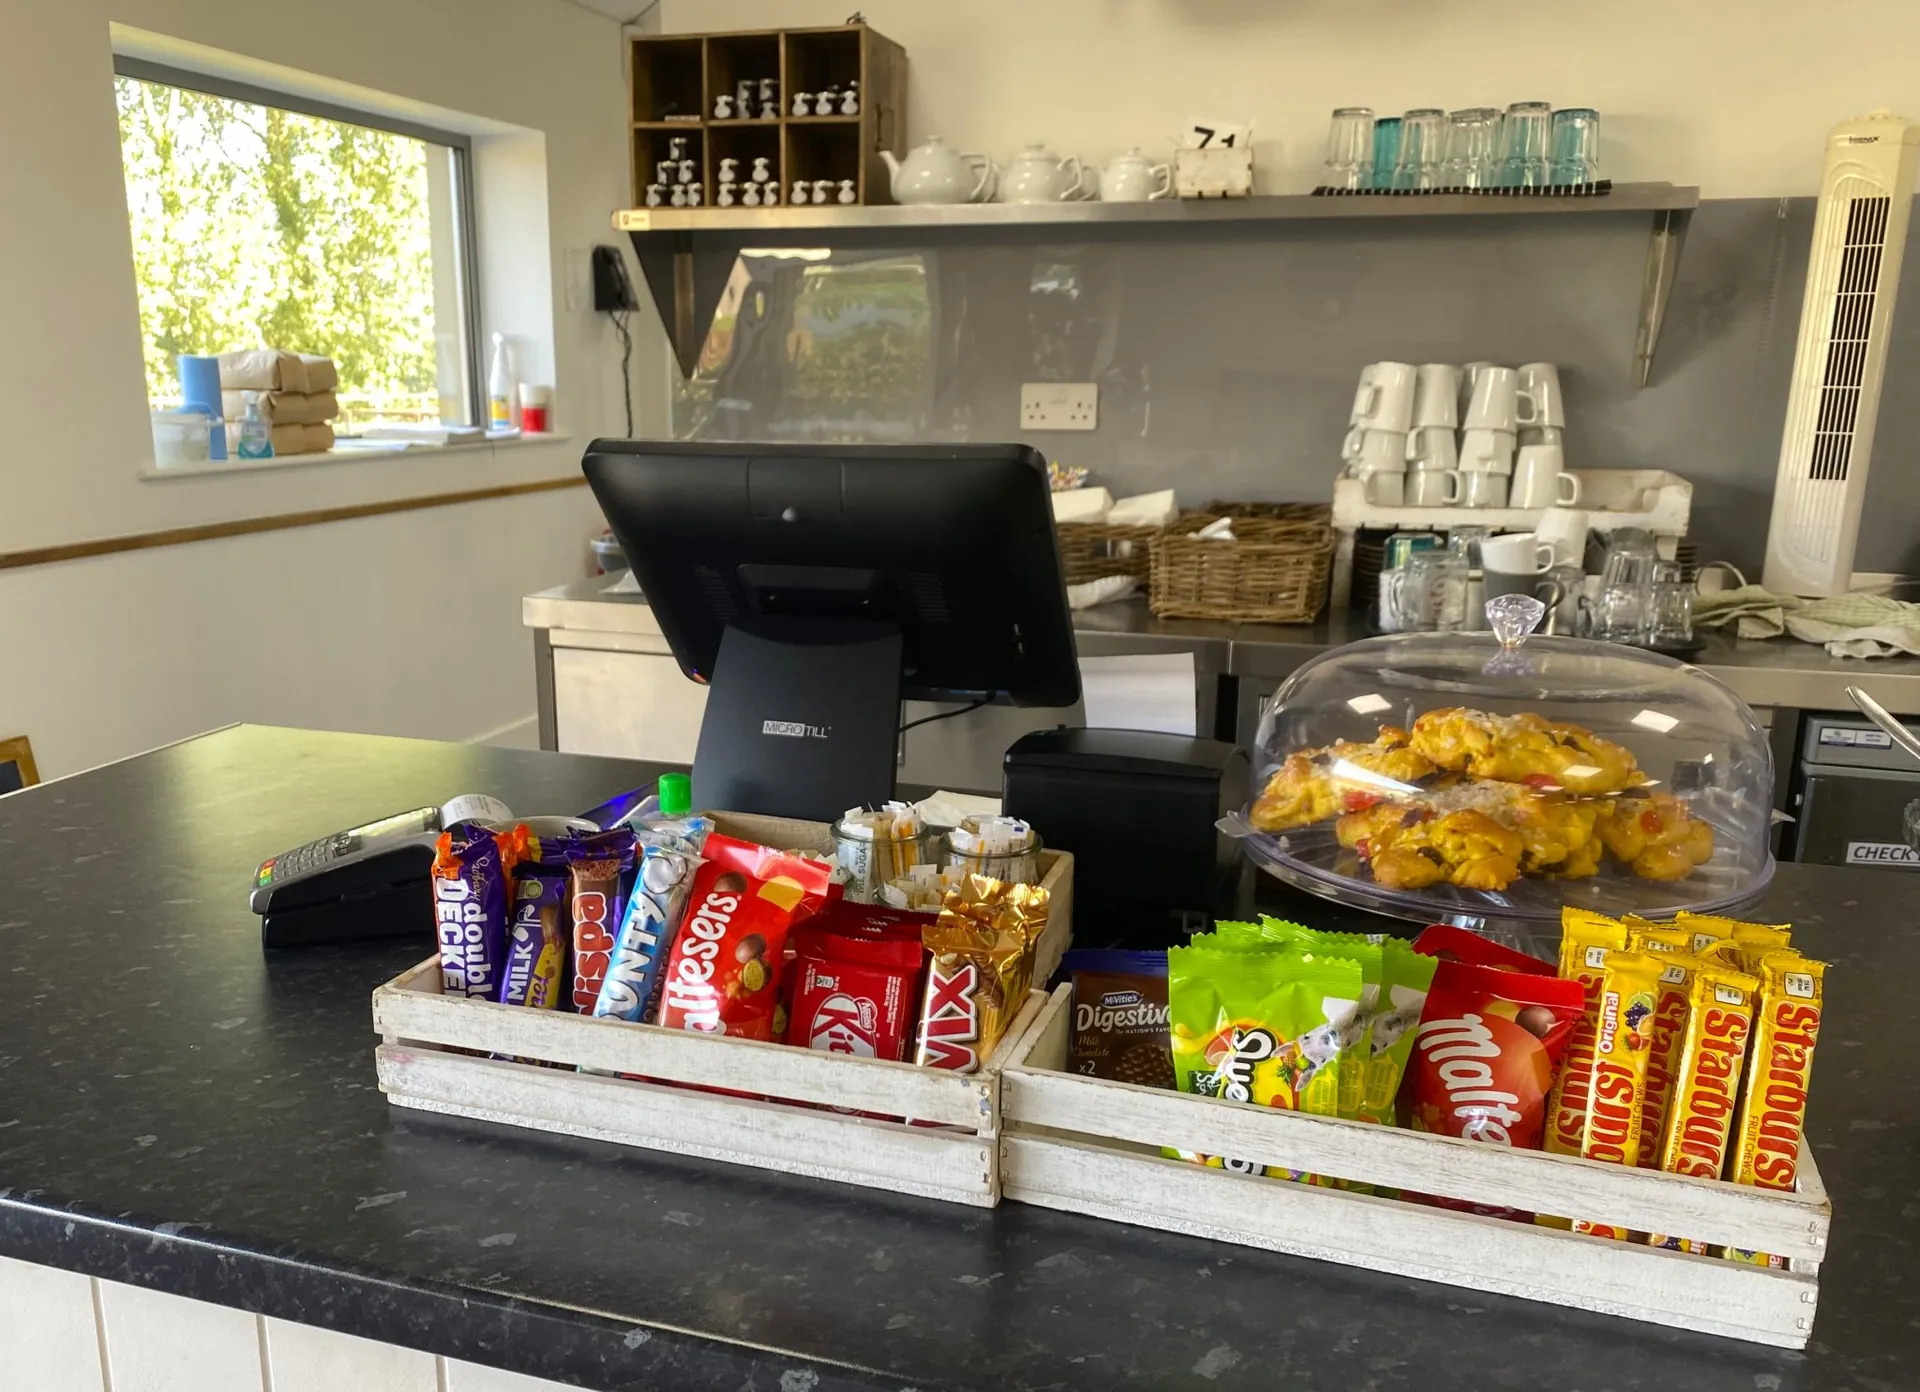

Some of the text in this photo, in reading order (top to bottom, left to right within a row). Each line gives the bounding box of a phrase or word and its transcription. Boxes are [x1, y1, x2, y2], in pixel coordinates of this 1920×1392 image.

[764, 720, 828, 738] MICROTILL
[1854, 845, 1911, 861] CHECK
[506, 941, 535, 1001] MILK
[598, 890, 668, 1021] UNTY
[667, 891, 740, 1036] altesers
[812, 1008, 875, 1056] Kit
[1077, 1002, 1171, 1033] Digestiv
[1598, 991, 1620, 1055] Original
[1079, 1060, 1096, 1075] x2
[1631, 1081, 1645, 1141] FRUIT CHEWS
[1741, 1115, 1758, 1177] FRUIT CHEWS
